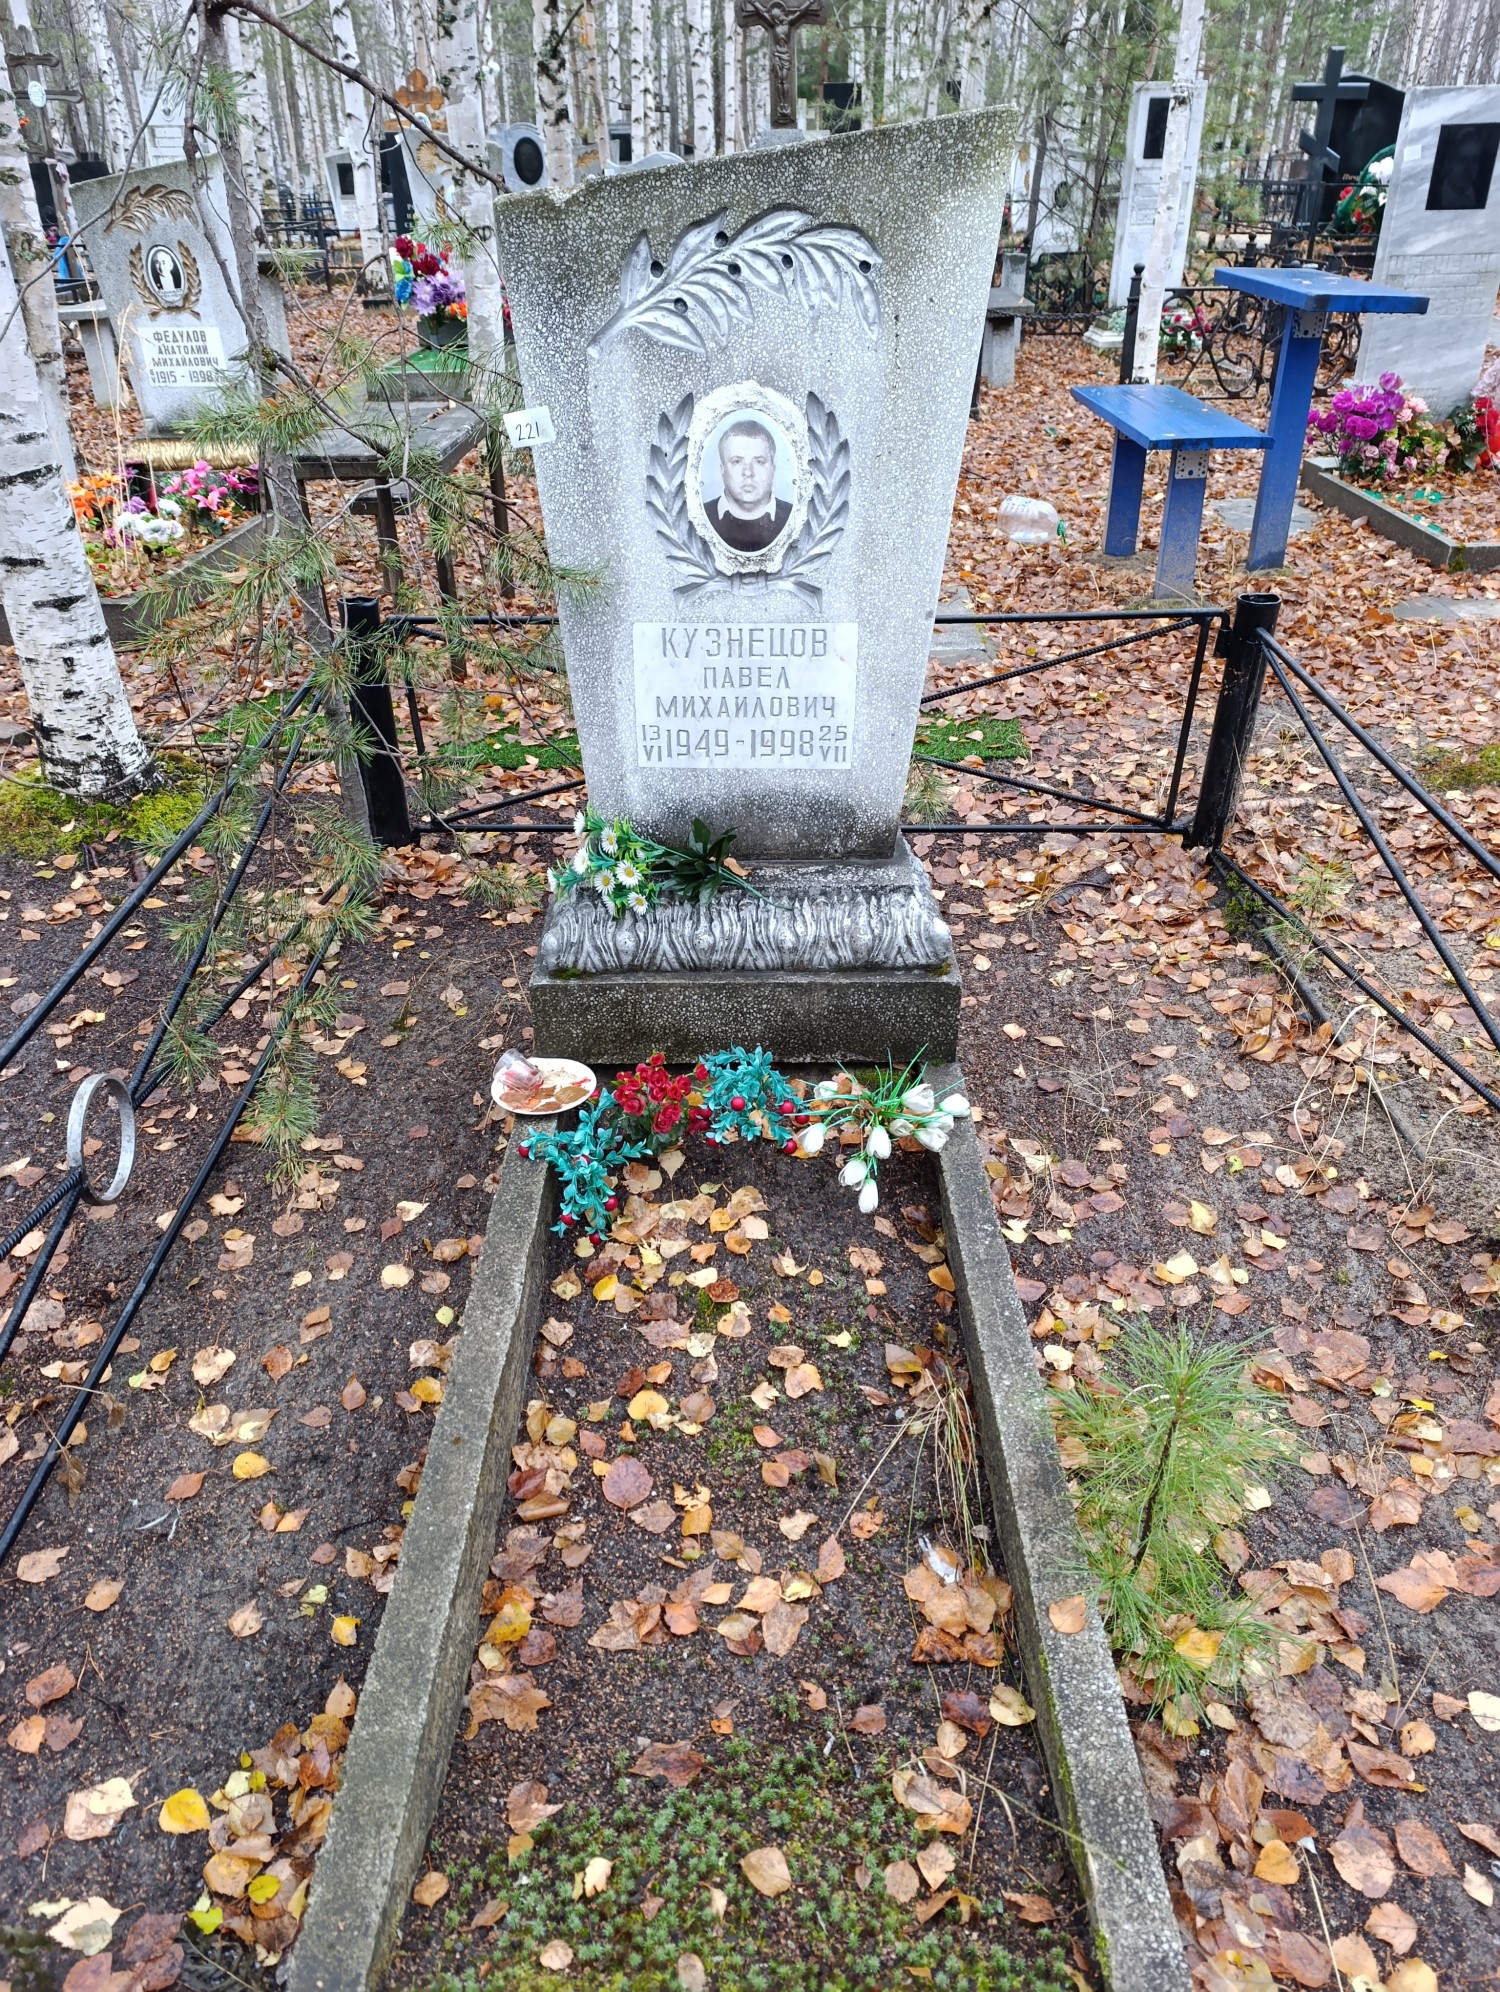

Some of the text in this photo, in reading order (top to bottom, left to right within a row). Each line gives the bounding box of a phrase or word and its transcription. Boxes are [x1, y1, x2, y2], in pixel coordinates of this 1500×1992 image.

[152, 330, 207, 343] ФЕДУЛОВ
[155, 370, 177, 383] 1915
[188, 370, 214, 383] 1998
[515, 421, 540, 441] 221
[661, 627, 828, 658] КУЗНЕЦОВ
[703, 666, 790, 689] ПАВЕЛ
[641, 724, 661, 742] 13
[818, 725, 848, 742] 25
[643, 745, 663, 762] VI
[818, 745, 847, 763] VII
